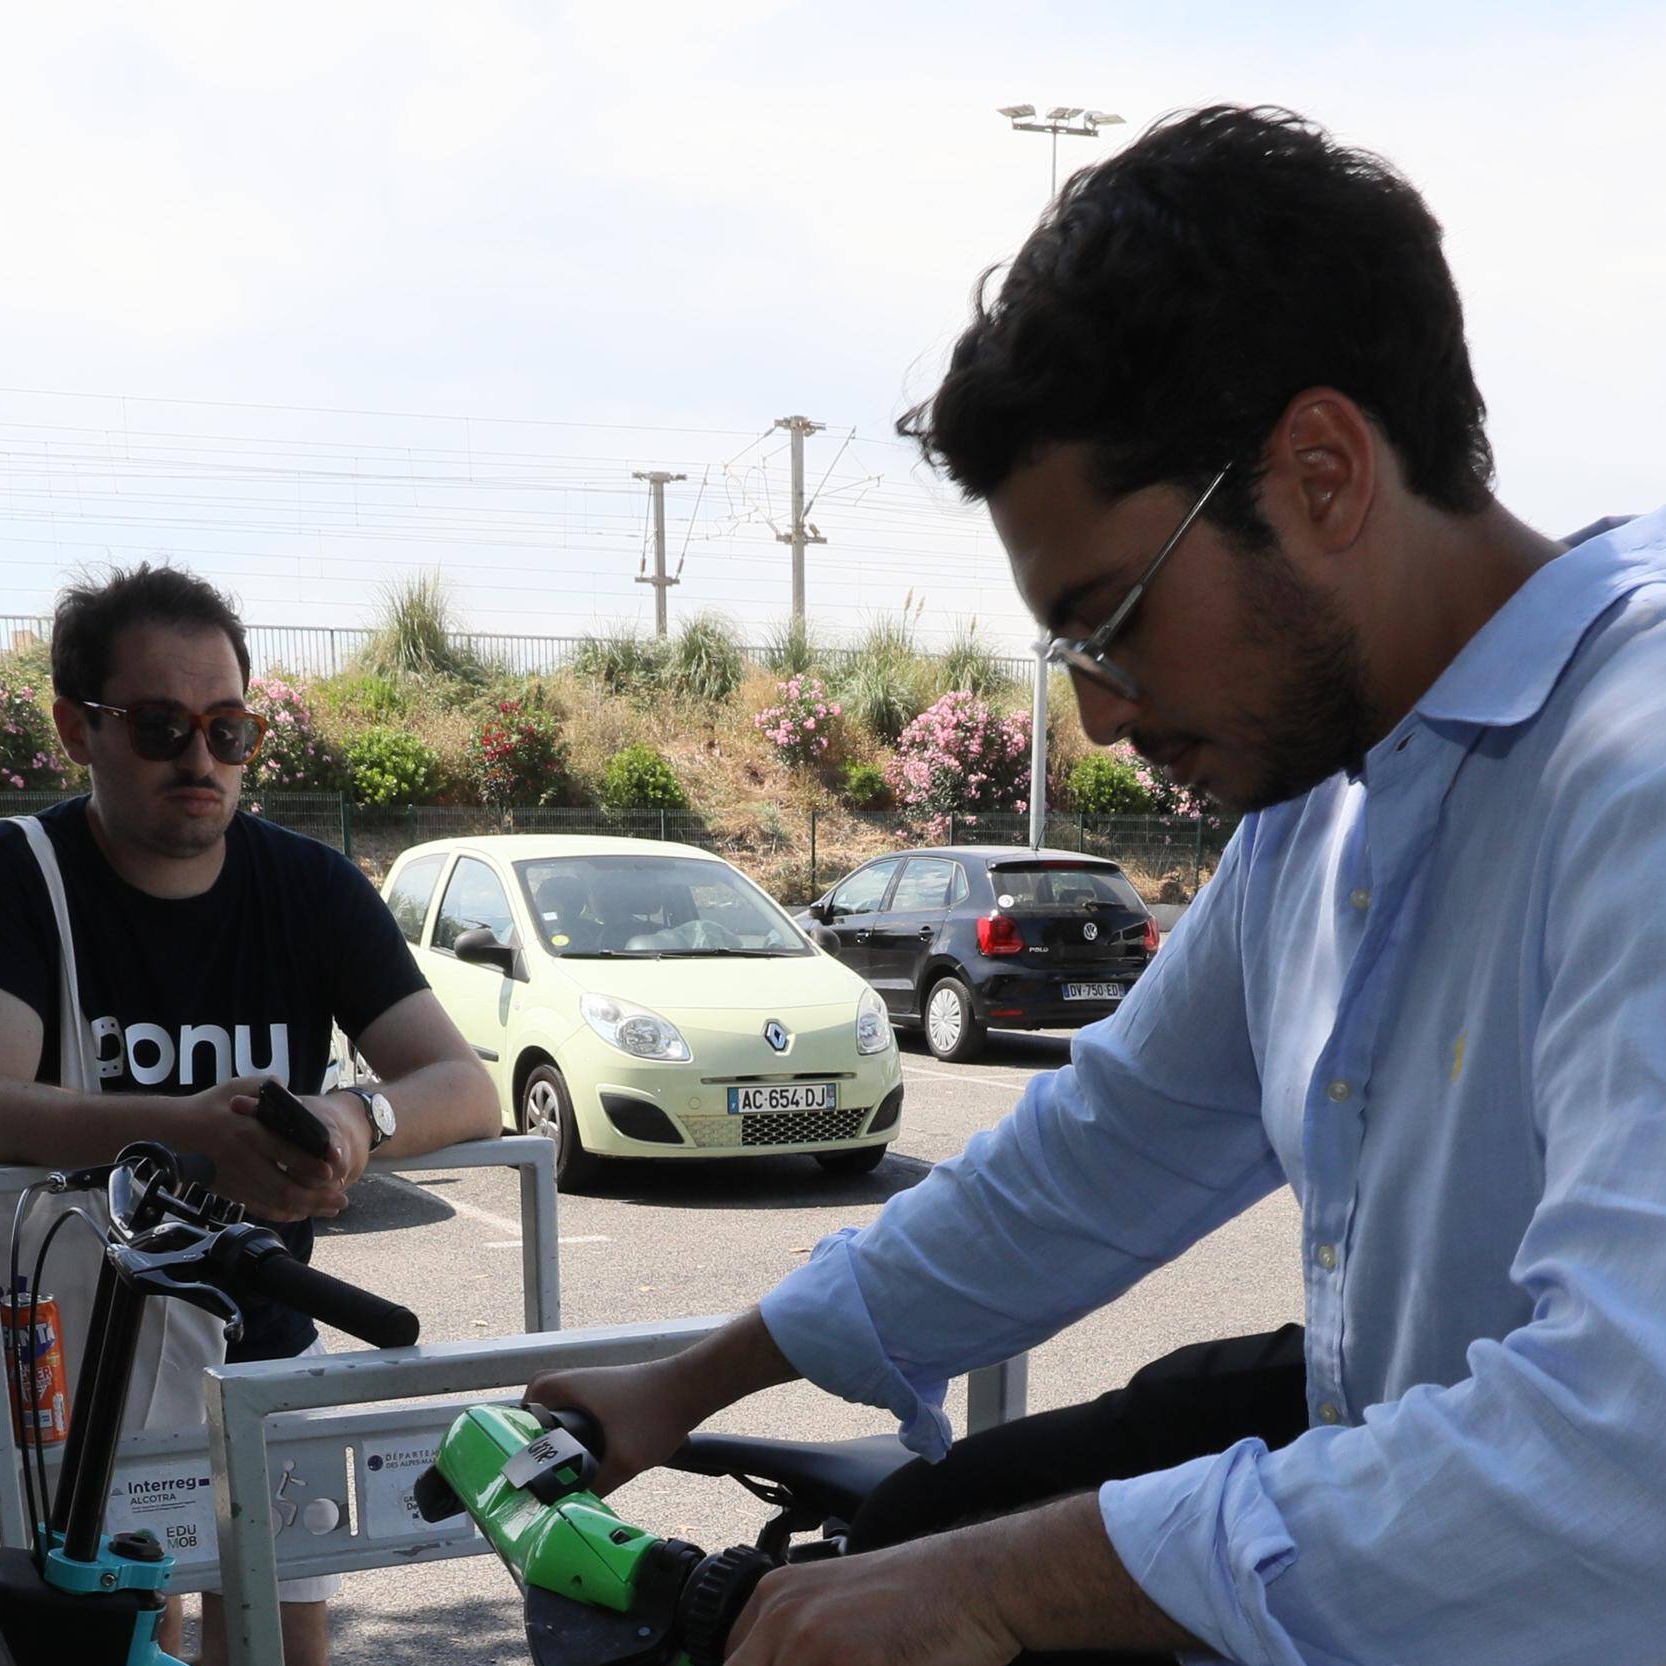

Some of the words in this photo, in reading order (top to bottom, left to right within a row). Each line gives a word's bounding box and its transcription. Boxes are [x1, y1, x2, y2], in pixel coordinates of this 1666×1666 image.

[741, 1087, 826, 1110] AC-654-DJ
[128, 1476, 197, 1495] Interreg
[130, 1493, 177, 1506] ALCOTRA
[166, 1524, 197, 1538] EDU
[167, 1536, 198, 1550] MOB
